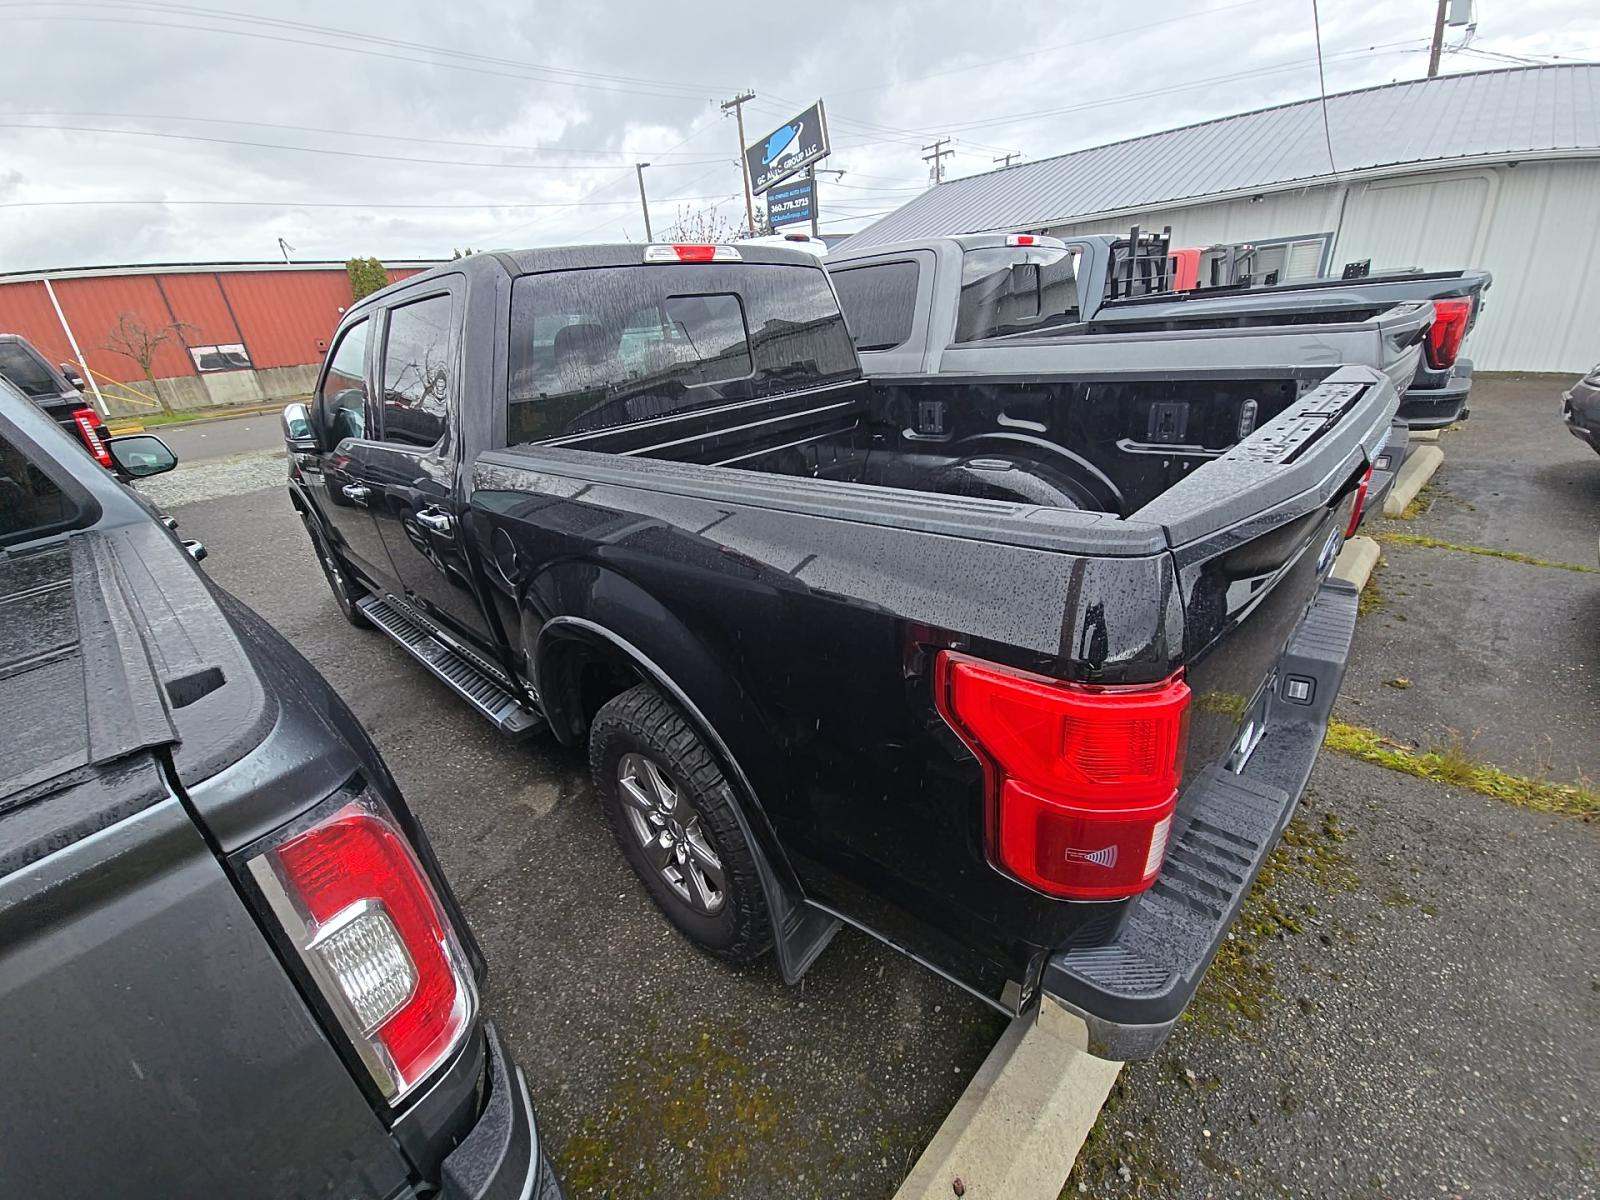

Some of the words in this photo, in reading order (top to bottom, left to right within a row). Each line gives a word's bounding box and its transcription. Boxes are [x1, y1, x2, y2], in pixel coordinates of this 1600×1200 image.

[757, 174, 767, 186] GC
[784, 152, 804, 168] GROUP
[805, 144, 817, 157] LLC
